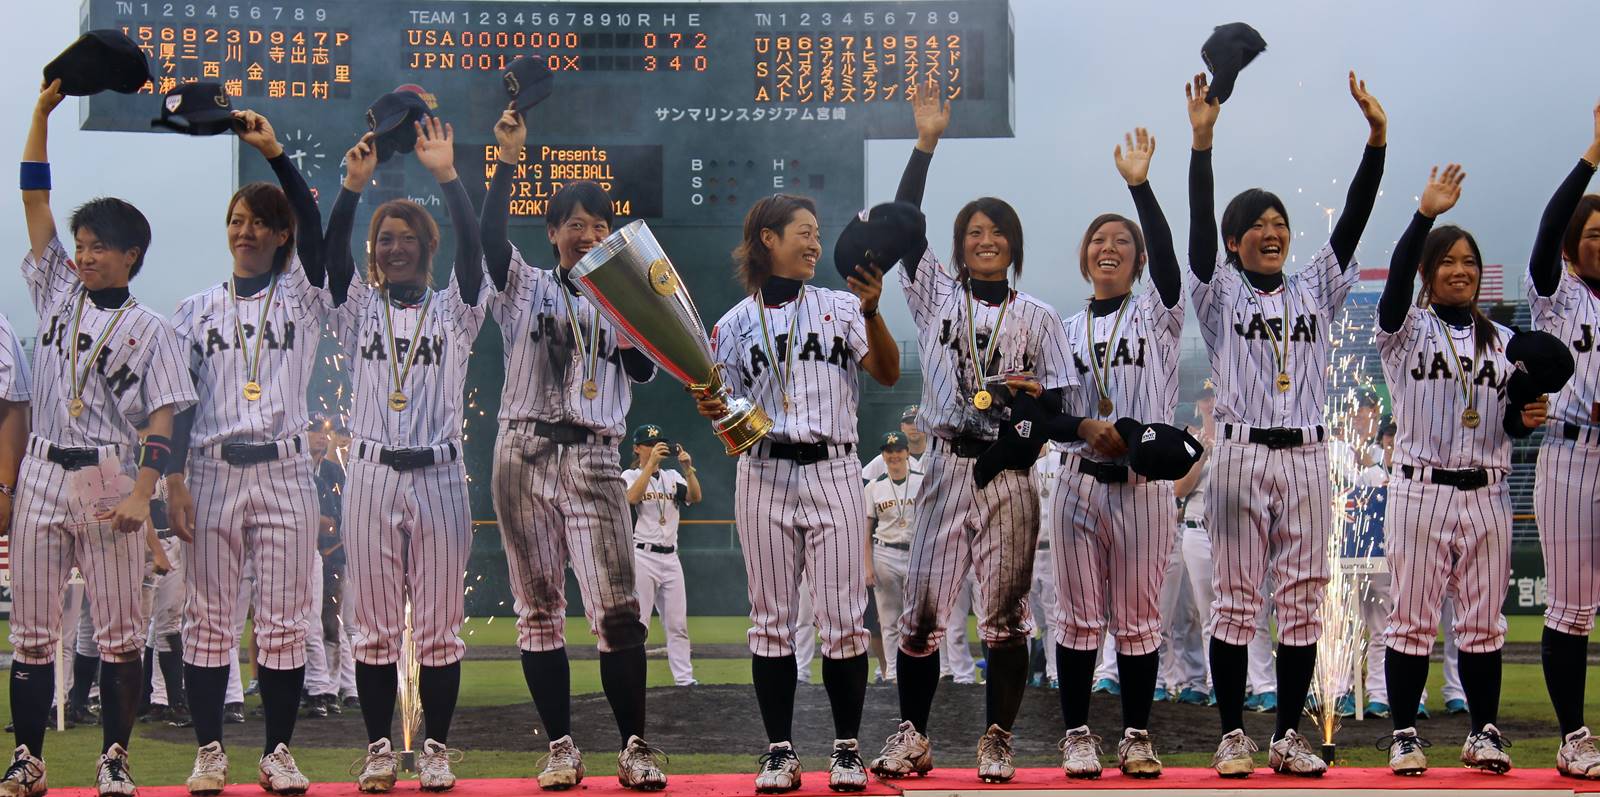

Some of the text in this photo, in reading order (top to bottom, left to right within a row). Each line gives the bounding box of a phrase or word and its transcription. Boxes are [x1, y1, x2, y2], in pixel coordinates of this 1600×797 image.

[116, 2, 325, 21] TN 1 2 3 4 5 6 7 8 9
[409, 11, 700, 26] TEAM 1 2 3 4 5 6 7 8 9 10 R H E
[756, 12, 958, 25] TN 1 2 3 4 5 6 7 8 9
[139, 27, 153, 41] 5
[161, 28, 175, 42] 6
[183, 28, 197, 42] 8
[205, 29, 219, 43] 2
[227, 30, 241, 44] 3
[249, 31, 262, 44] D
[270, 32, 285, 45] 9
[292, 32, 305, 46] 4
[314, 32, 327, 46] 7
[335, 33, 349, 46] P
[408, 30, 707, 48] USA 0 0 0 0 0 0 0 0 7 2
[776, 37, 791, 50] 8
[798, 37, 812, 50] 6
[820, 37, 833, 49] 3
[841, 37, 854, 49] 7
[865, 37, 873, 49] 1
[883, 36, 896, 49] 9
[904, 36, 918, 49] 5
[926, 36, 938, 49] 4
[947, 35, 961, 48] 2
[410, 53, 707, 71] JPN 0 0 1 0 X 3 4 0
[655, 107, 846, 121] サンマリンスタジアム宮崎
[485, 146, 607, 161] ENS Presents
[692, 159, 703, 170] B
[773, 159, 784, 170] H
[485, 164, 614, 179] WN'S BASEBALL
[691, 177, 702, 188] S
[773, 176, 784, 187] E
[692, 194, 703, 205] O
